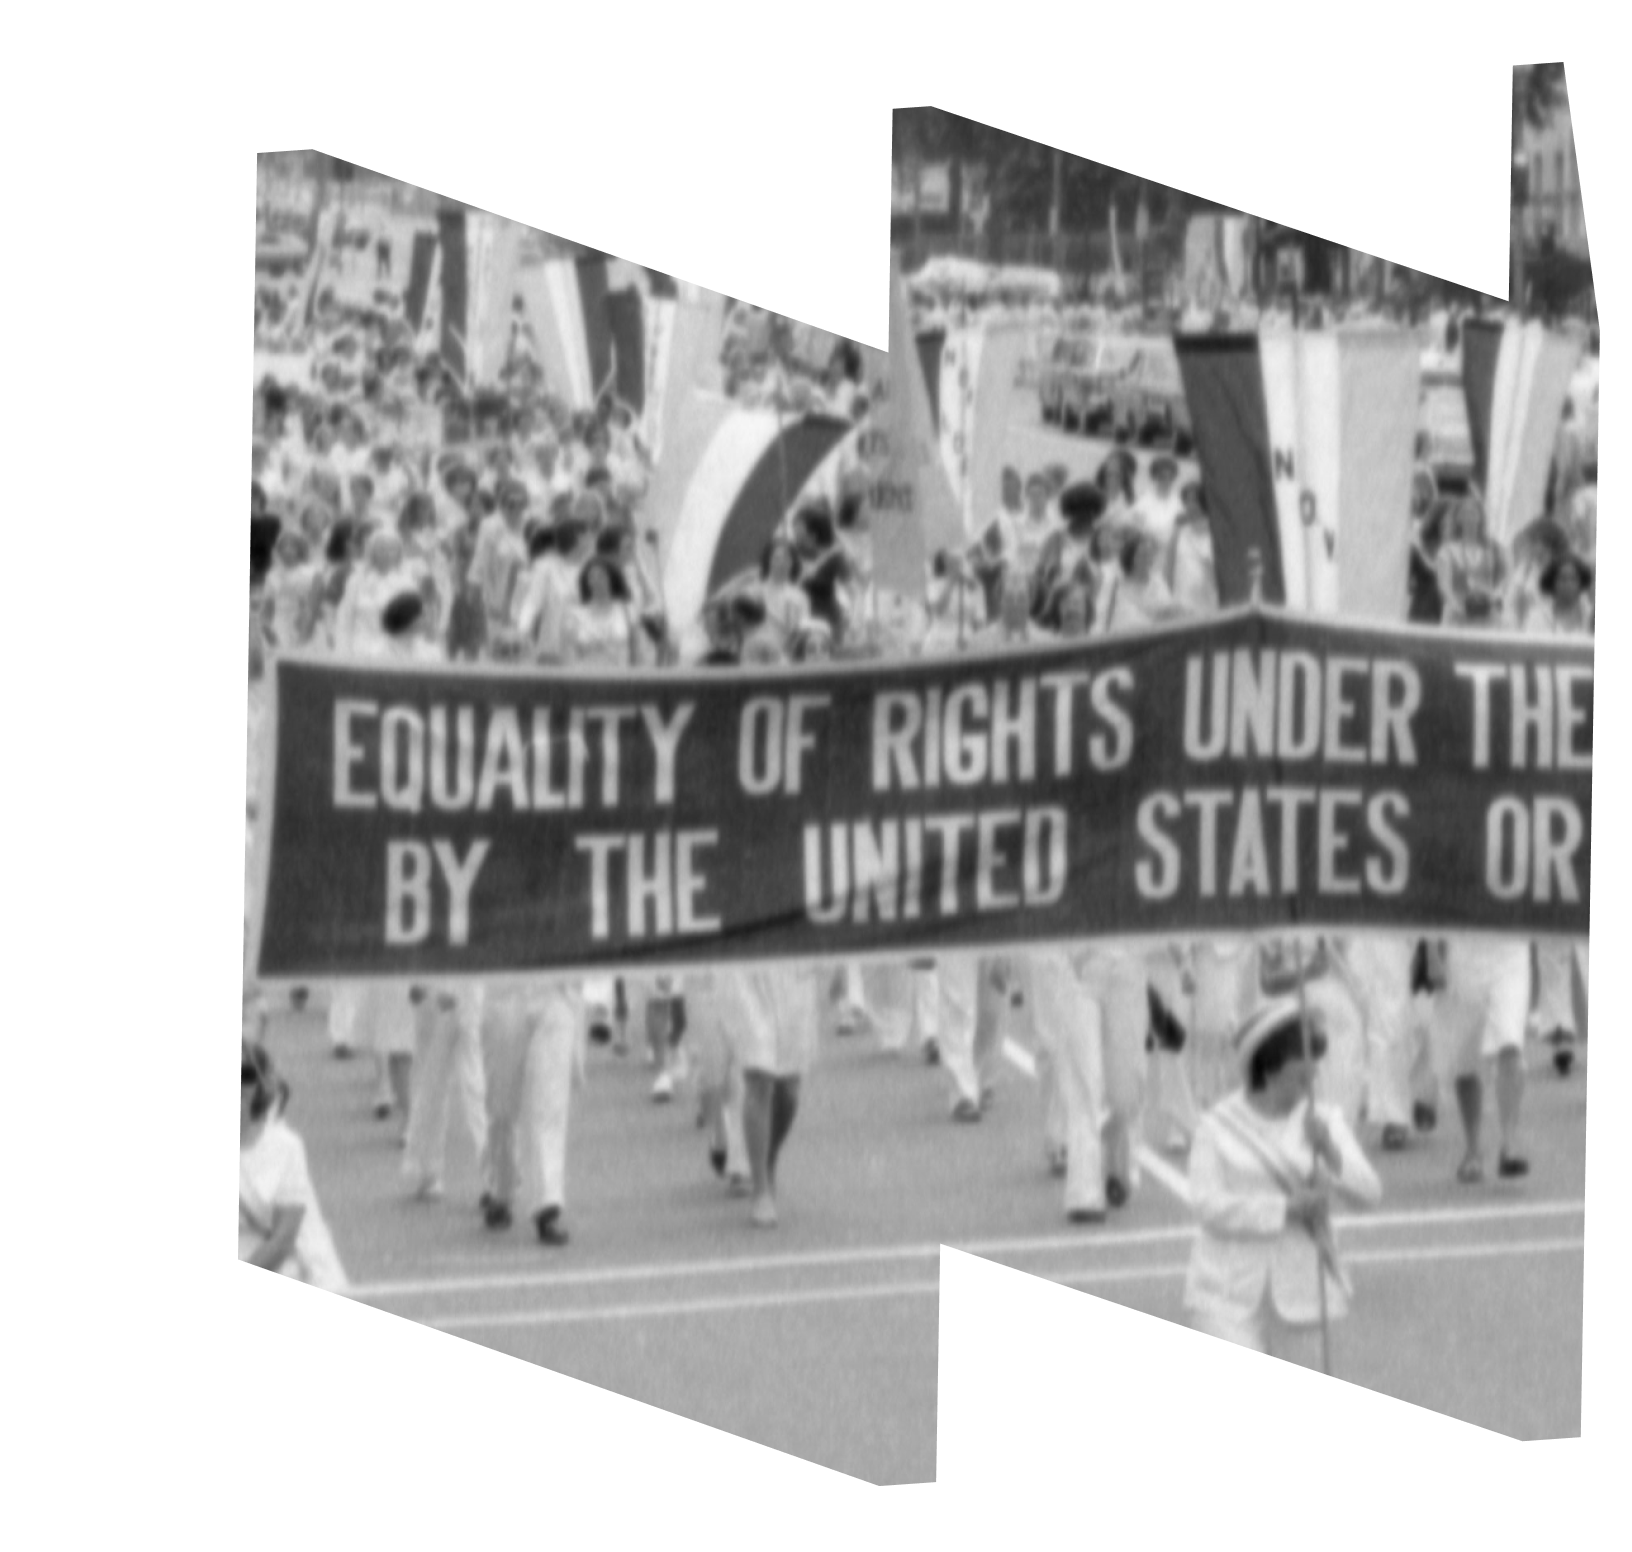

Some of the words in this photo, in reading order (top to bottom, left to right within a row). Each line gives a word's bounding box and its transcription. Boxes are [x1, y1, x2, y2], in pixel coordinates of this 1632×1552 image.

[332, 697, 694, 813] EQUALITY
[738, 694, 832, 796] OF
[870, 666, 1134, 790] RIGHTS
[1183, 647, 1421, 765] UNDER
[1453, 660, 1594, 770] THE
[384, 838, 490, 947] BY
[574, 827, 722, 940] THE
[802, 806, 1068, 923] UNITED
[1134, 786, 1410, 900] STATES
[1485, 794, 1584, 902] OR
